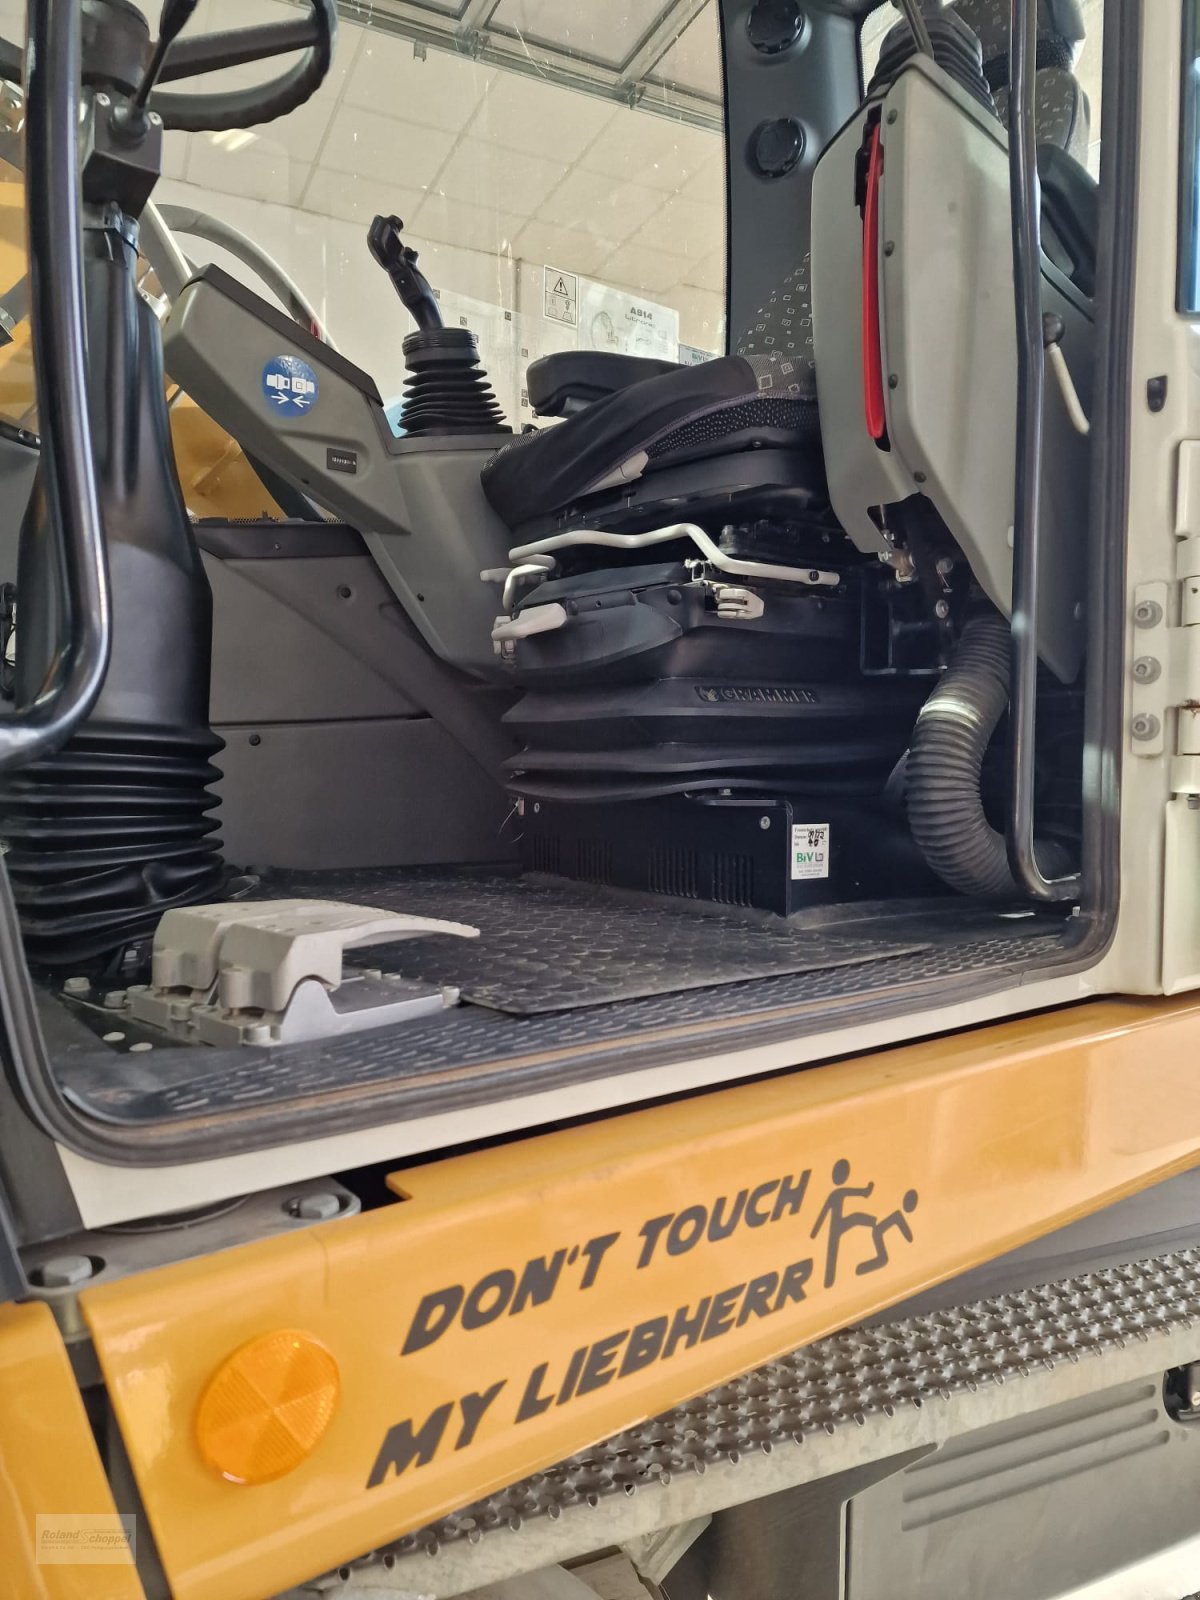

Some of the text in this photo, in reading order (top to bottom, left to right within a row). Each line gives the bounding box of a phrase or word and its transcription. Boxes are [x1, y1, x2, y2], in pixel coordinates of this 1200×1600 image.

[400, 1168, 812, 1357] DON'T TOUCH
[366, 1258, 814, 1490] MY LIEBHERR
